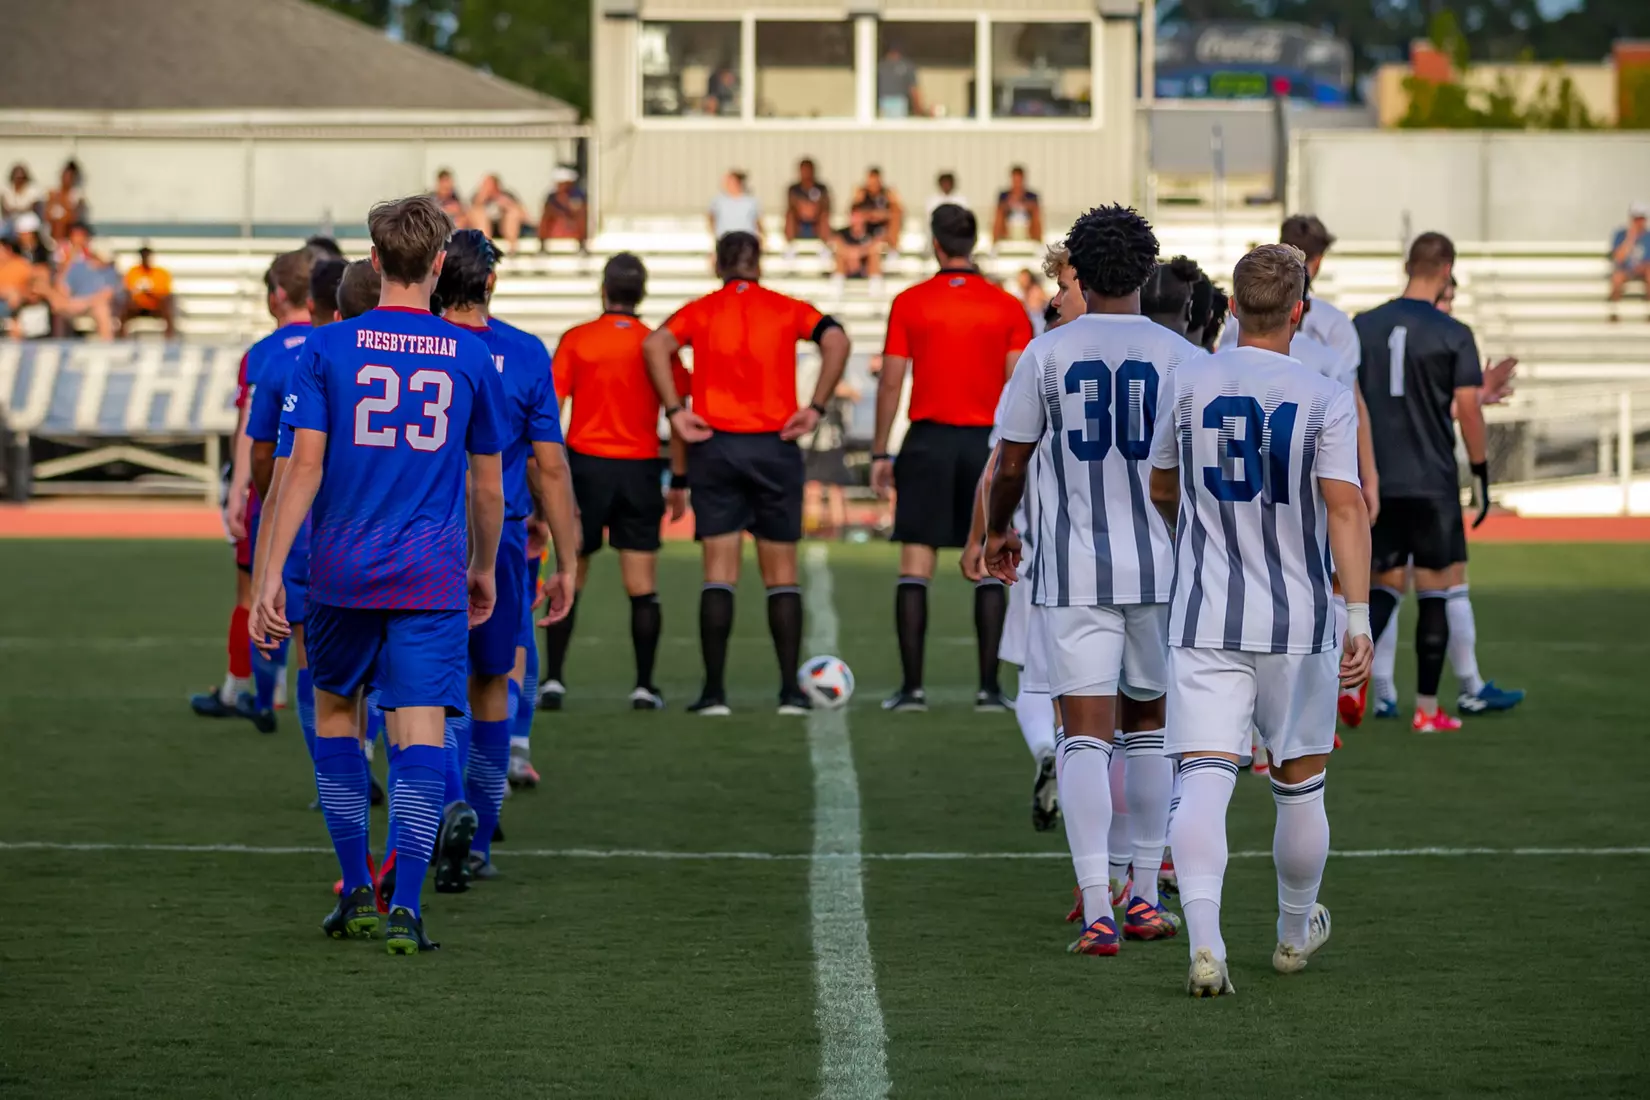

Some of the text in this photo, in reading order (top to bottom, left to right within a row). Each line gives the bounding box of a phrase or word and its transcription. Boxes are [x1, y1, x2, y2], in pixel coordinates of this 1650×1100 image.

[356, 329, 457, 358] PRESBYTERIAN
[1388, 325, 1407, 397] 1
[353, 363, 455, 452] 23
[1064, 359, 1159, 461] 30
[1202, 395, 1298, 505] 31
